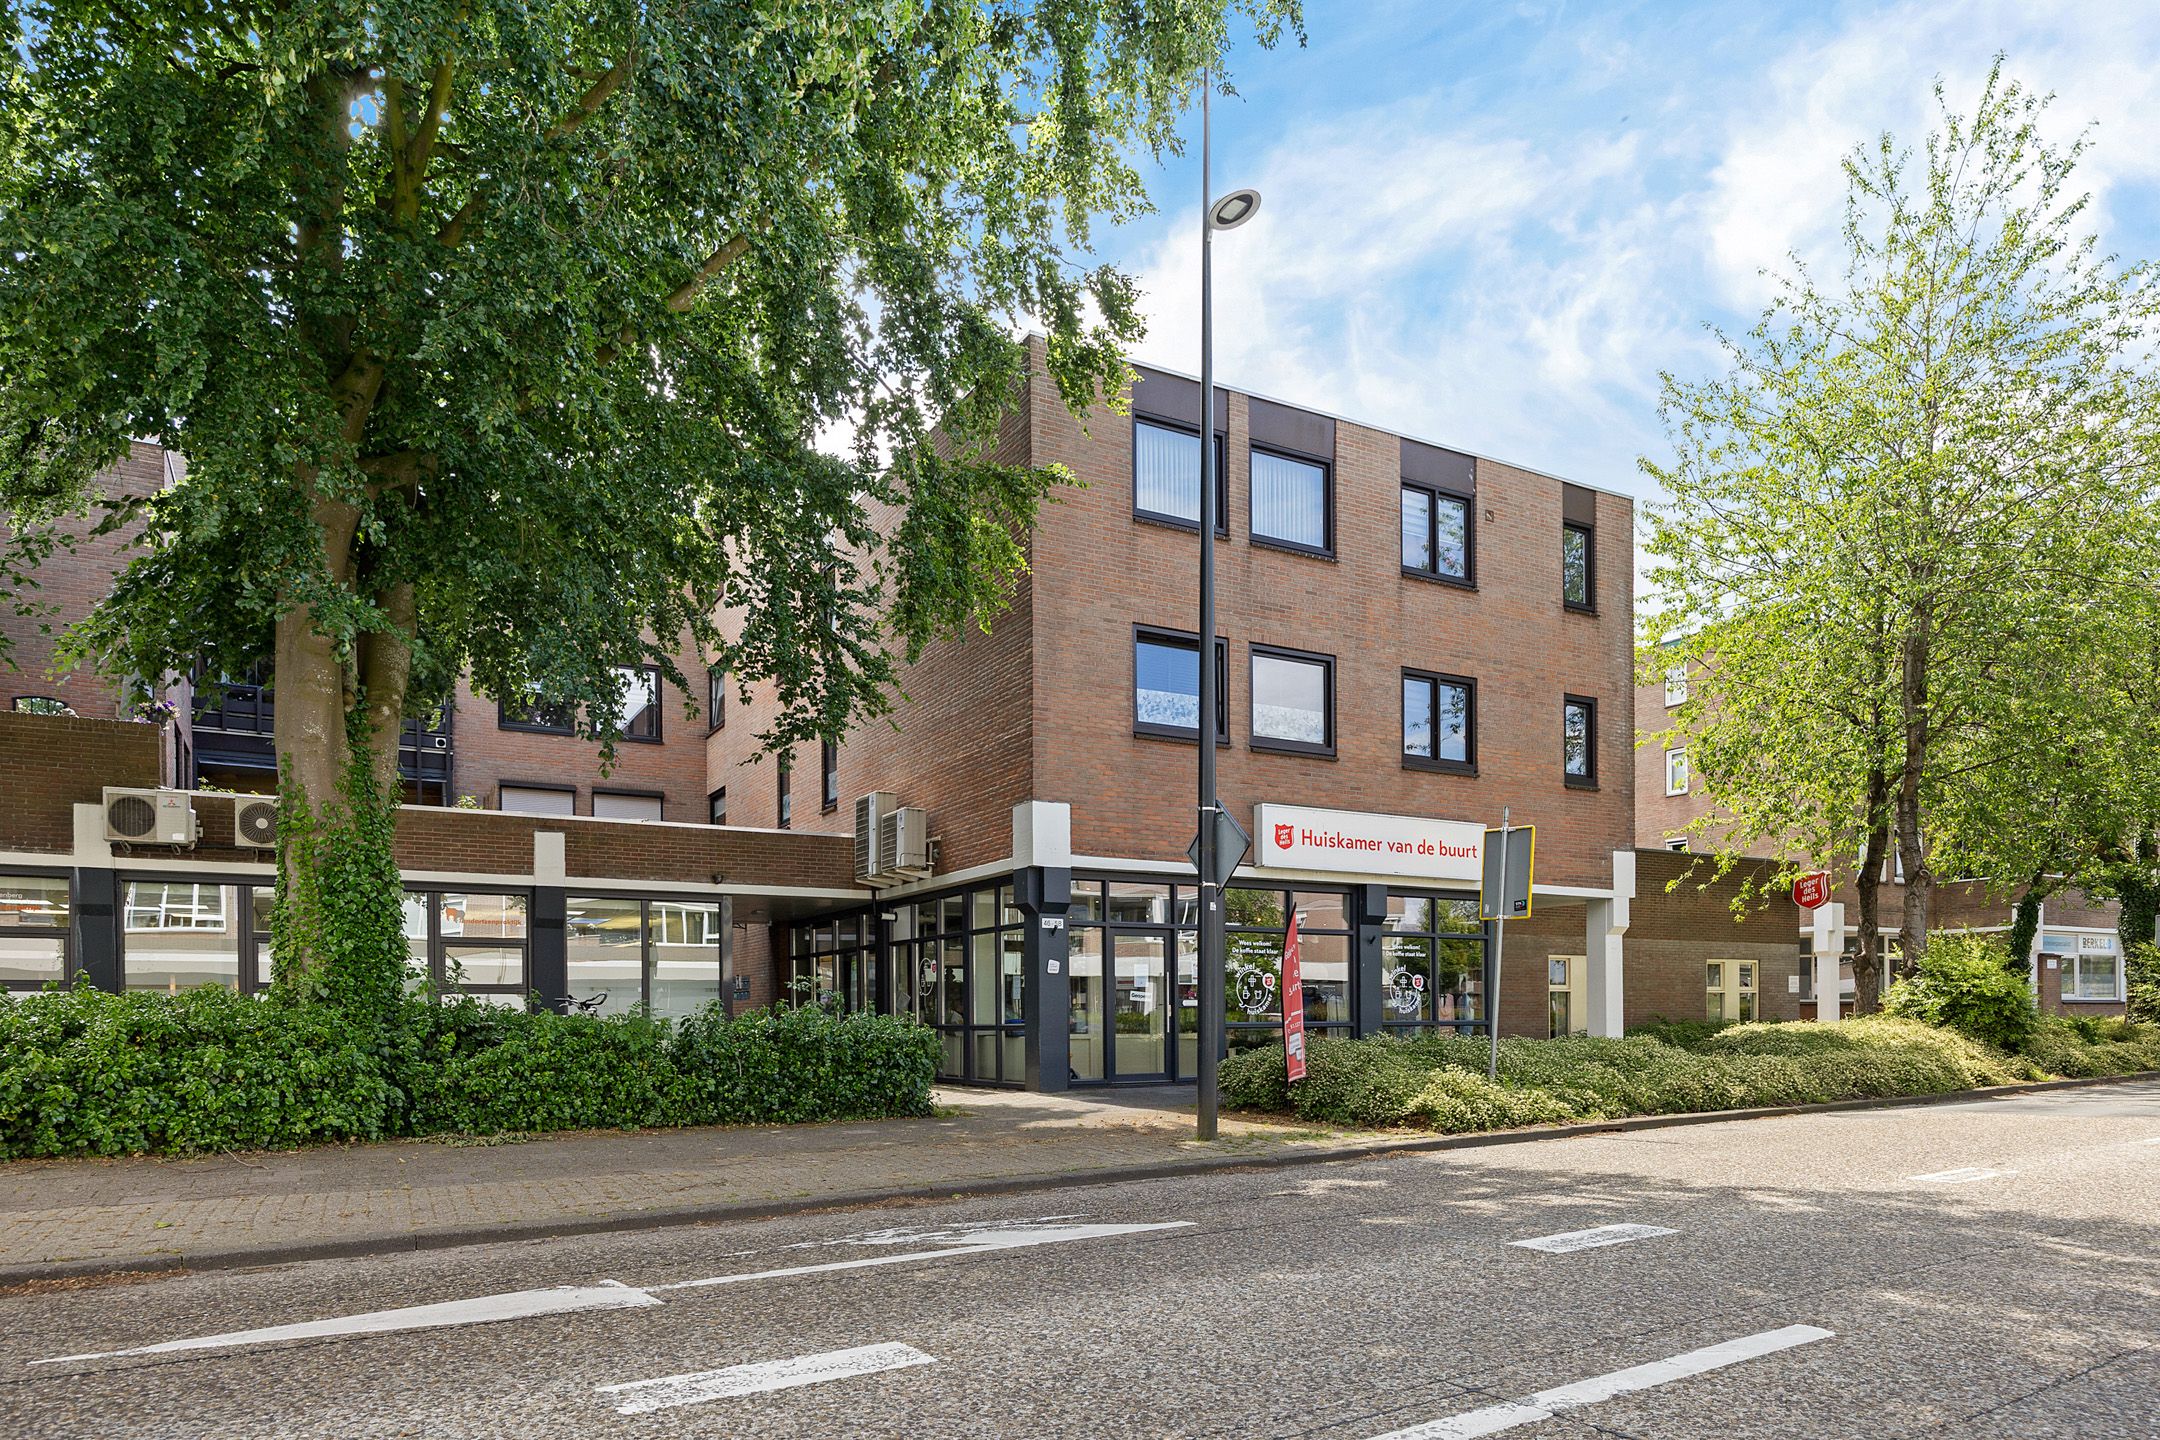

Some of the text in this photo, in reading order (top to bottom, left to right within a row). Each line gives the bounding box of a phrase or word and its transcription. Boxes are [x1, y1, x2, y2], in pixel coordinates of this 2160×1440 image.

[1301, 828, 1477, 858] Huiskamer van de buurt
[1800, 877, 1819, 889] Leger
[1803, 886, 1816, 895] des
[1801, 893, 1819, 903] Heils
[1235, 962, 1255, 977] winkel
[1389, 964, 1406, 979] winkel
[1246, 993, 1273, 1015] huiskamer
[1399, 993, 1421, 1014] huiskamer
